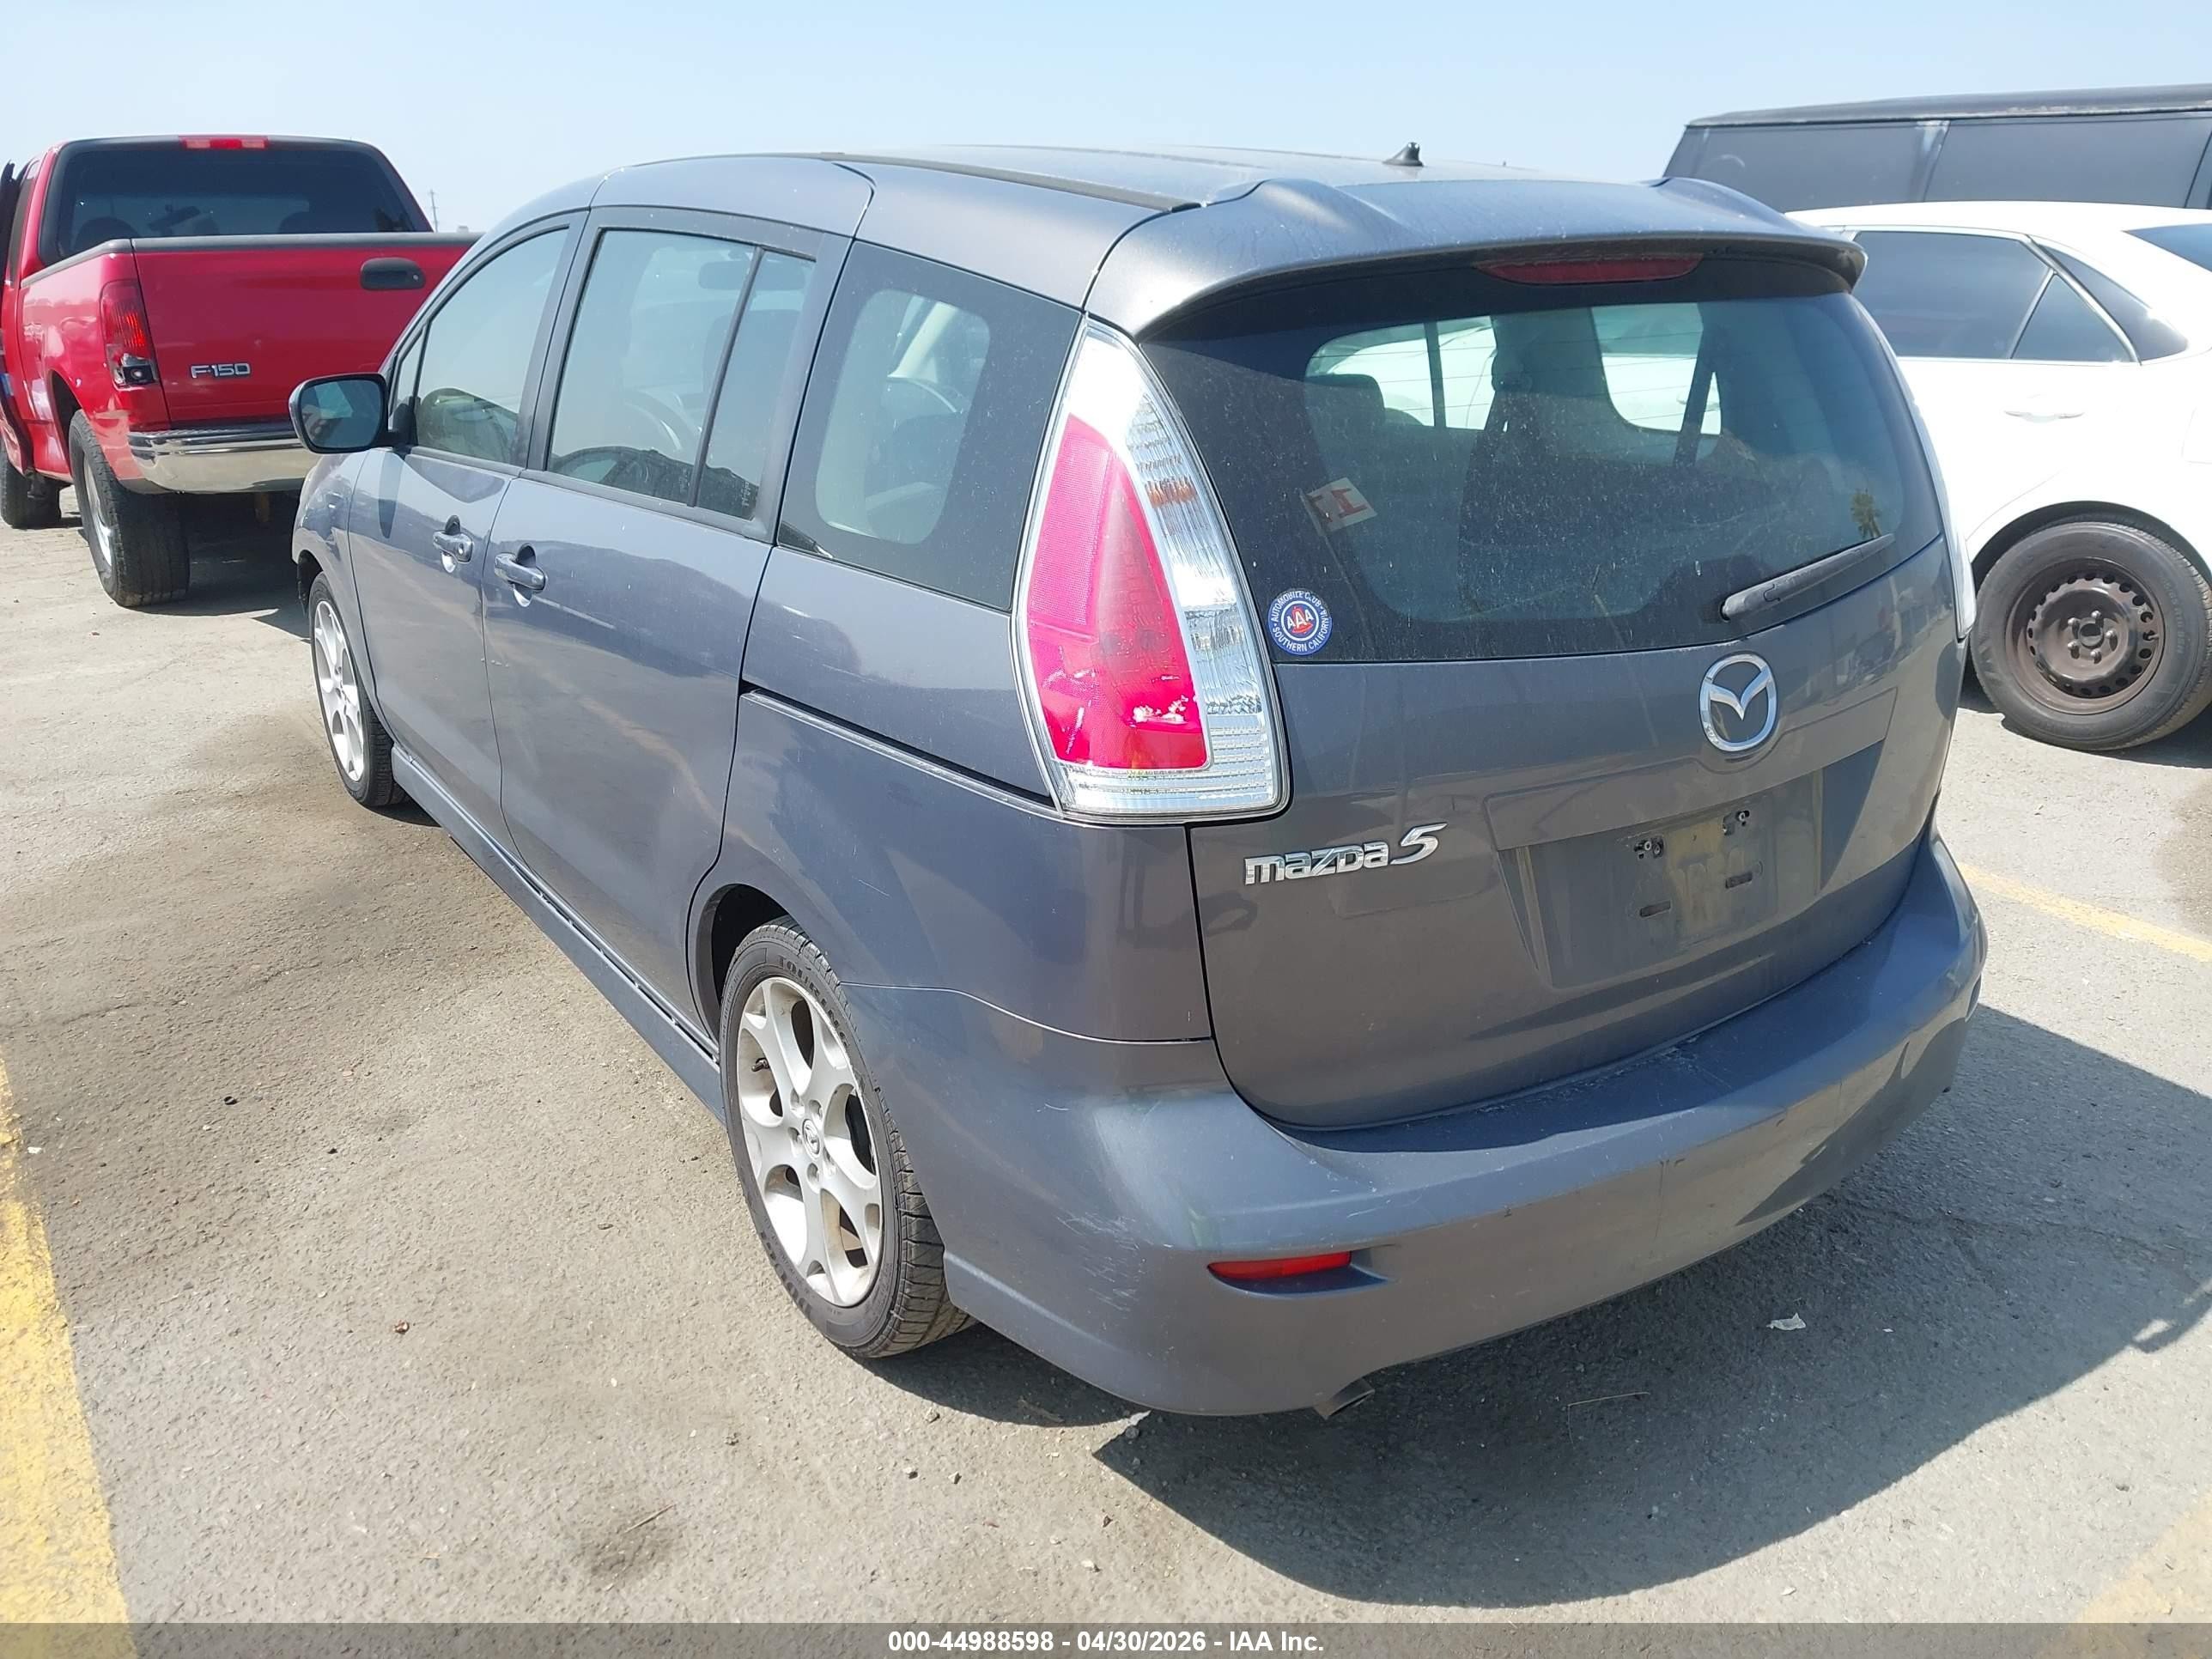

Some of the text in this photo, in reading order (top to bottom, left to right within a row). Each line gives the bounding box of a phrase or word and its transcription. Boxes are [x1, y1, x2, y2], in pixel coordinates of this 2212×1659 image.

[1271, 590, 1322, 623] AUTOMOBILE CLUB
[1286, 608, 1315, 629] AAA
[1272, 608, 1330, 653] SOUTHERN CALIFORNIA
